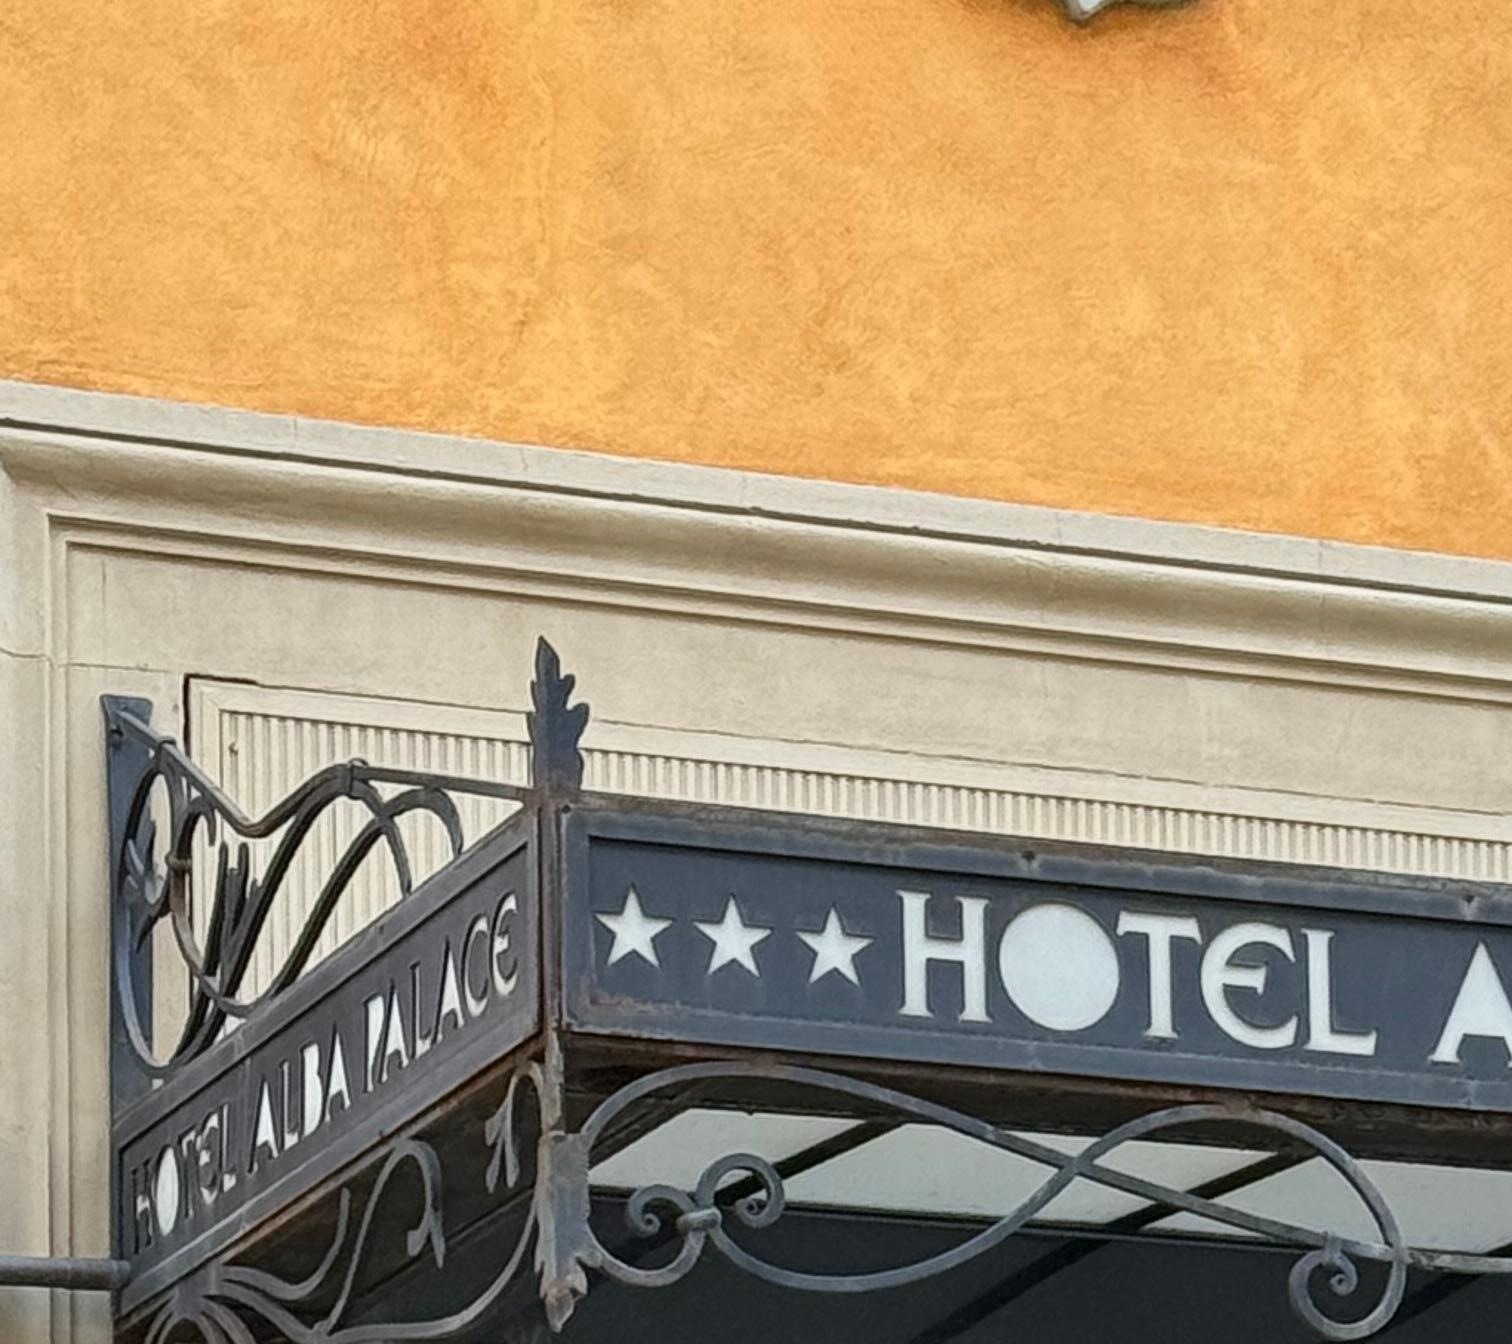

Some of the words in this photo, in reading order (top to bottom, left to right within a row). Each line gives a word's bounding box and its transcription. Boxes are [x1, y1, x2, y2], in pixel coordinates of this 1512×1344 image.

[132, 1104, 236, 1253] HOTEL
[248, 1023, 351, 1174] ALBA
[364, 893, 518, 1092] PALACE
[896, 888, 1377, 1056] HOTEL
